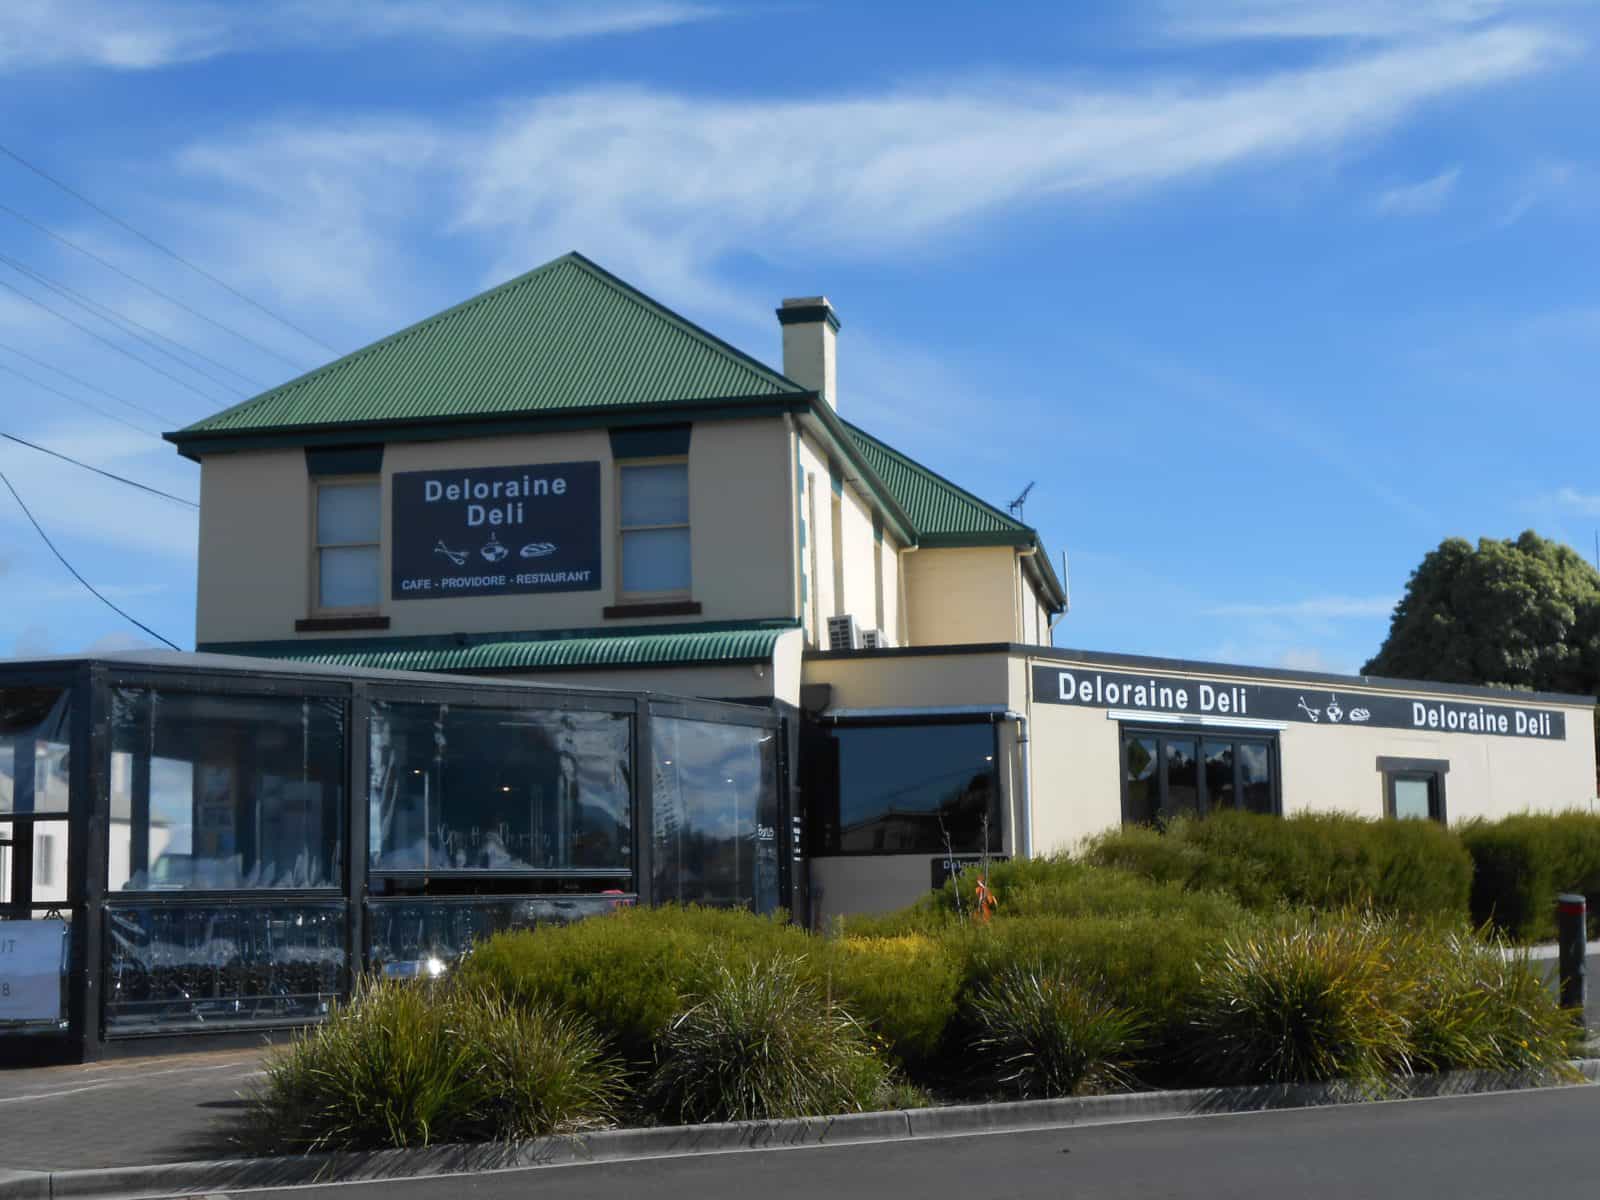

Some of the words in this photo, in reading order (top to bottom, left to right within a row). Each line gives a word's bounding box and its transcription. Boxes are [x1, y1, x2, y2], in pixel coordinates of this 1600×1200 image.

[425, 475, 567, 501] Deloraine
[467, 502, 524, 527] Deli
[401, 579, 432, 591] CAFE
[441, 575, 506, 589] PROVIDORE
[516, 570, 591, 584] RESTAURANT
[1058, 672, 1188, 708] Deloraine
[1199, 685, 1248, 714] Deli
[1412, 702, 1508, 732] Deloraine
[1515, 711, 1551, 736] Deli
